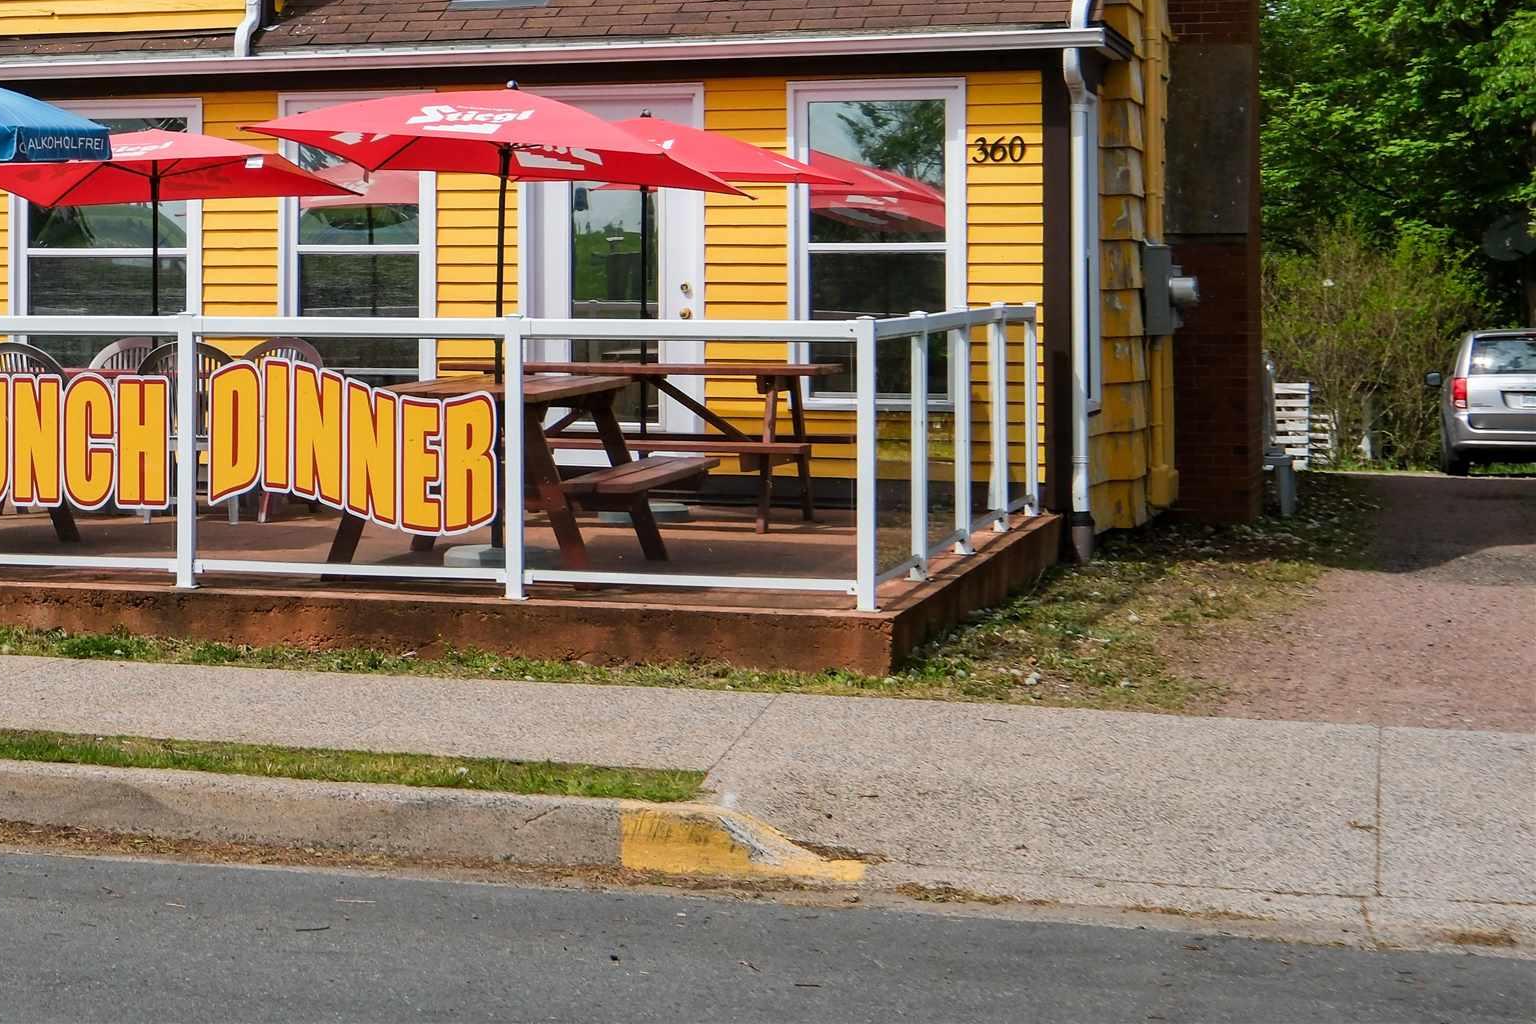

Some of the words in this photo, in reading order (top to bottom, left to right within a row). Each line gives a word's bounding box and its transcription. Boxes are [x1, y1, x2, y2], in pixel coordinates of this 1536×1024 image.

[406, 104, 535, 125] Stiegl
[28, 137, 104, 150] ALKOHOLFREI
[972, 135, 1026, 163] 360
[207, 356, 498, 537] DINNER
